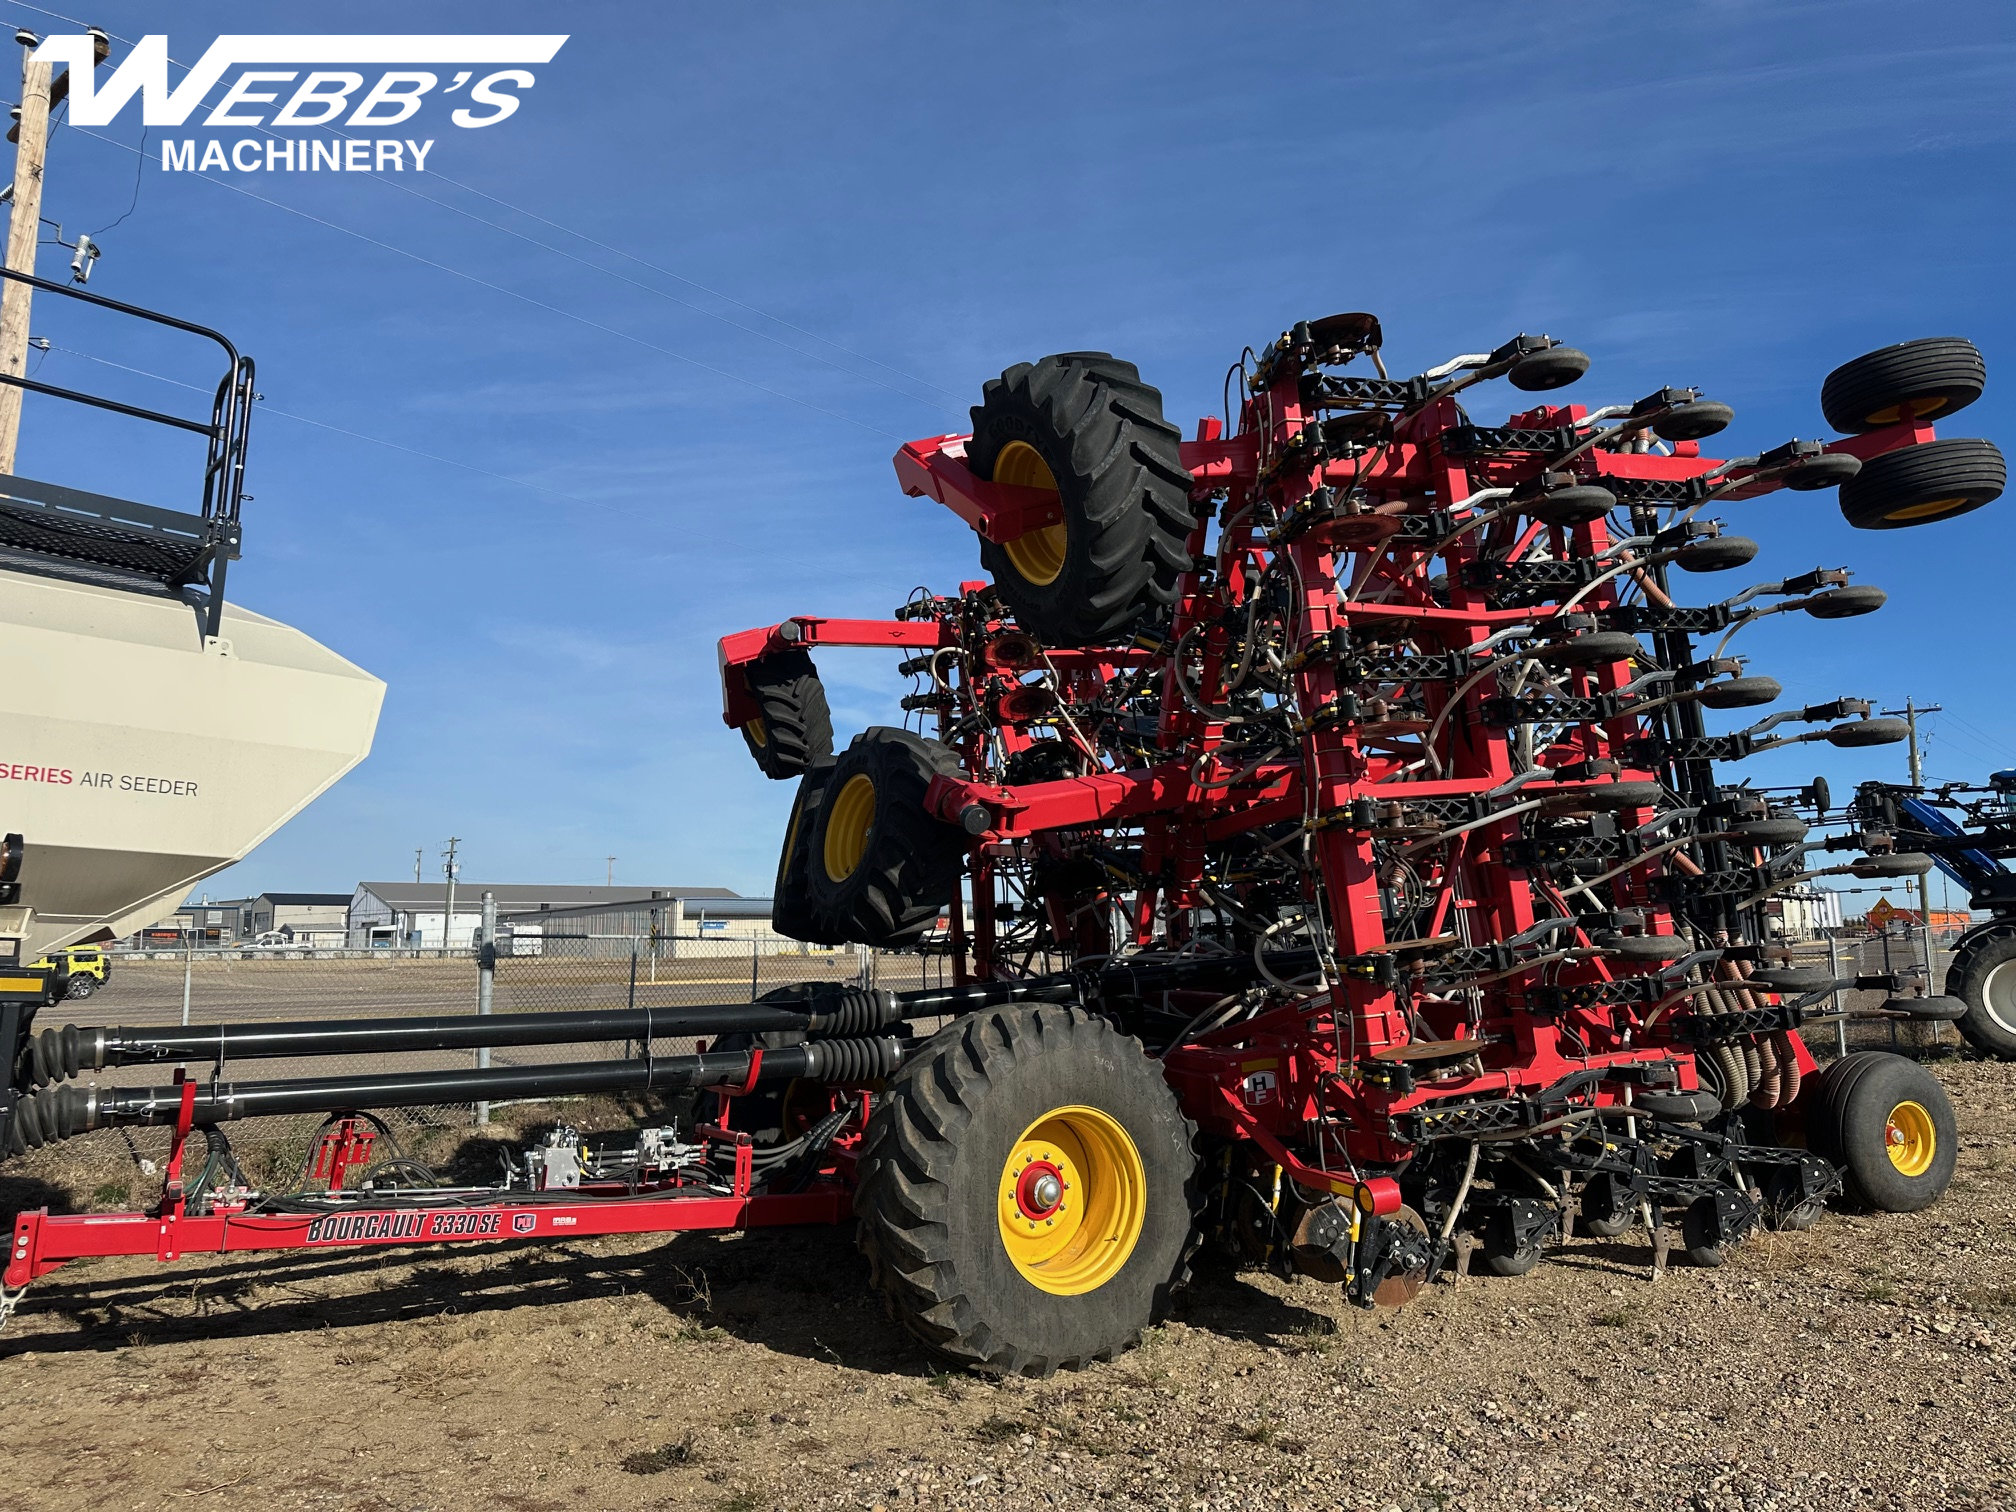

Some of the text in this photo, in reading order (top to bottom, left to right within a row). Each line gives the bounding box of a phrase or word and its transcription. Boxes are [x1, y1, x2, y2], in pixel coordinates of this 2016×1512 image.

[0, 763, 198, 797] SERIES AIR SEEDER
[1252, 1076, 1267, 1091] H
[306, 1213, 428, 1242] BOURGAULT
